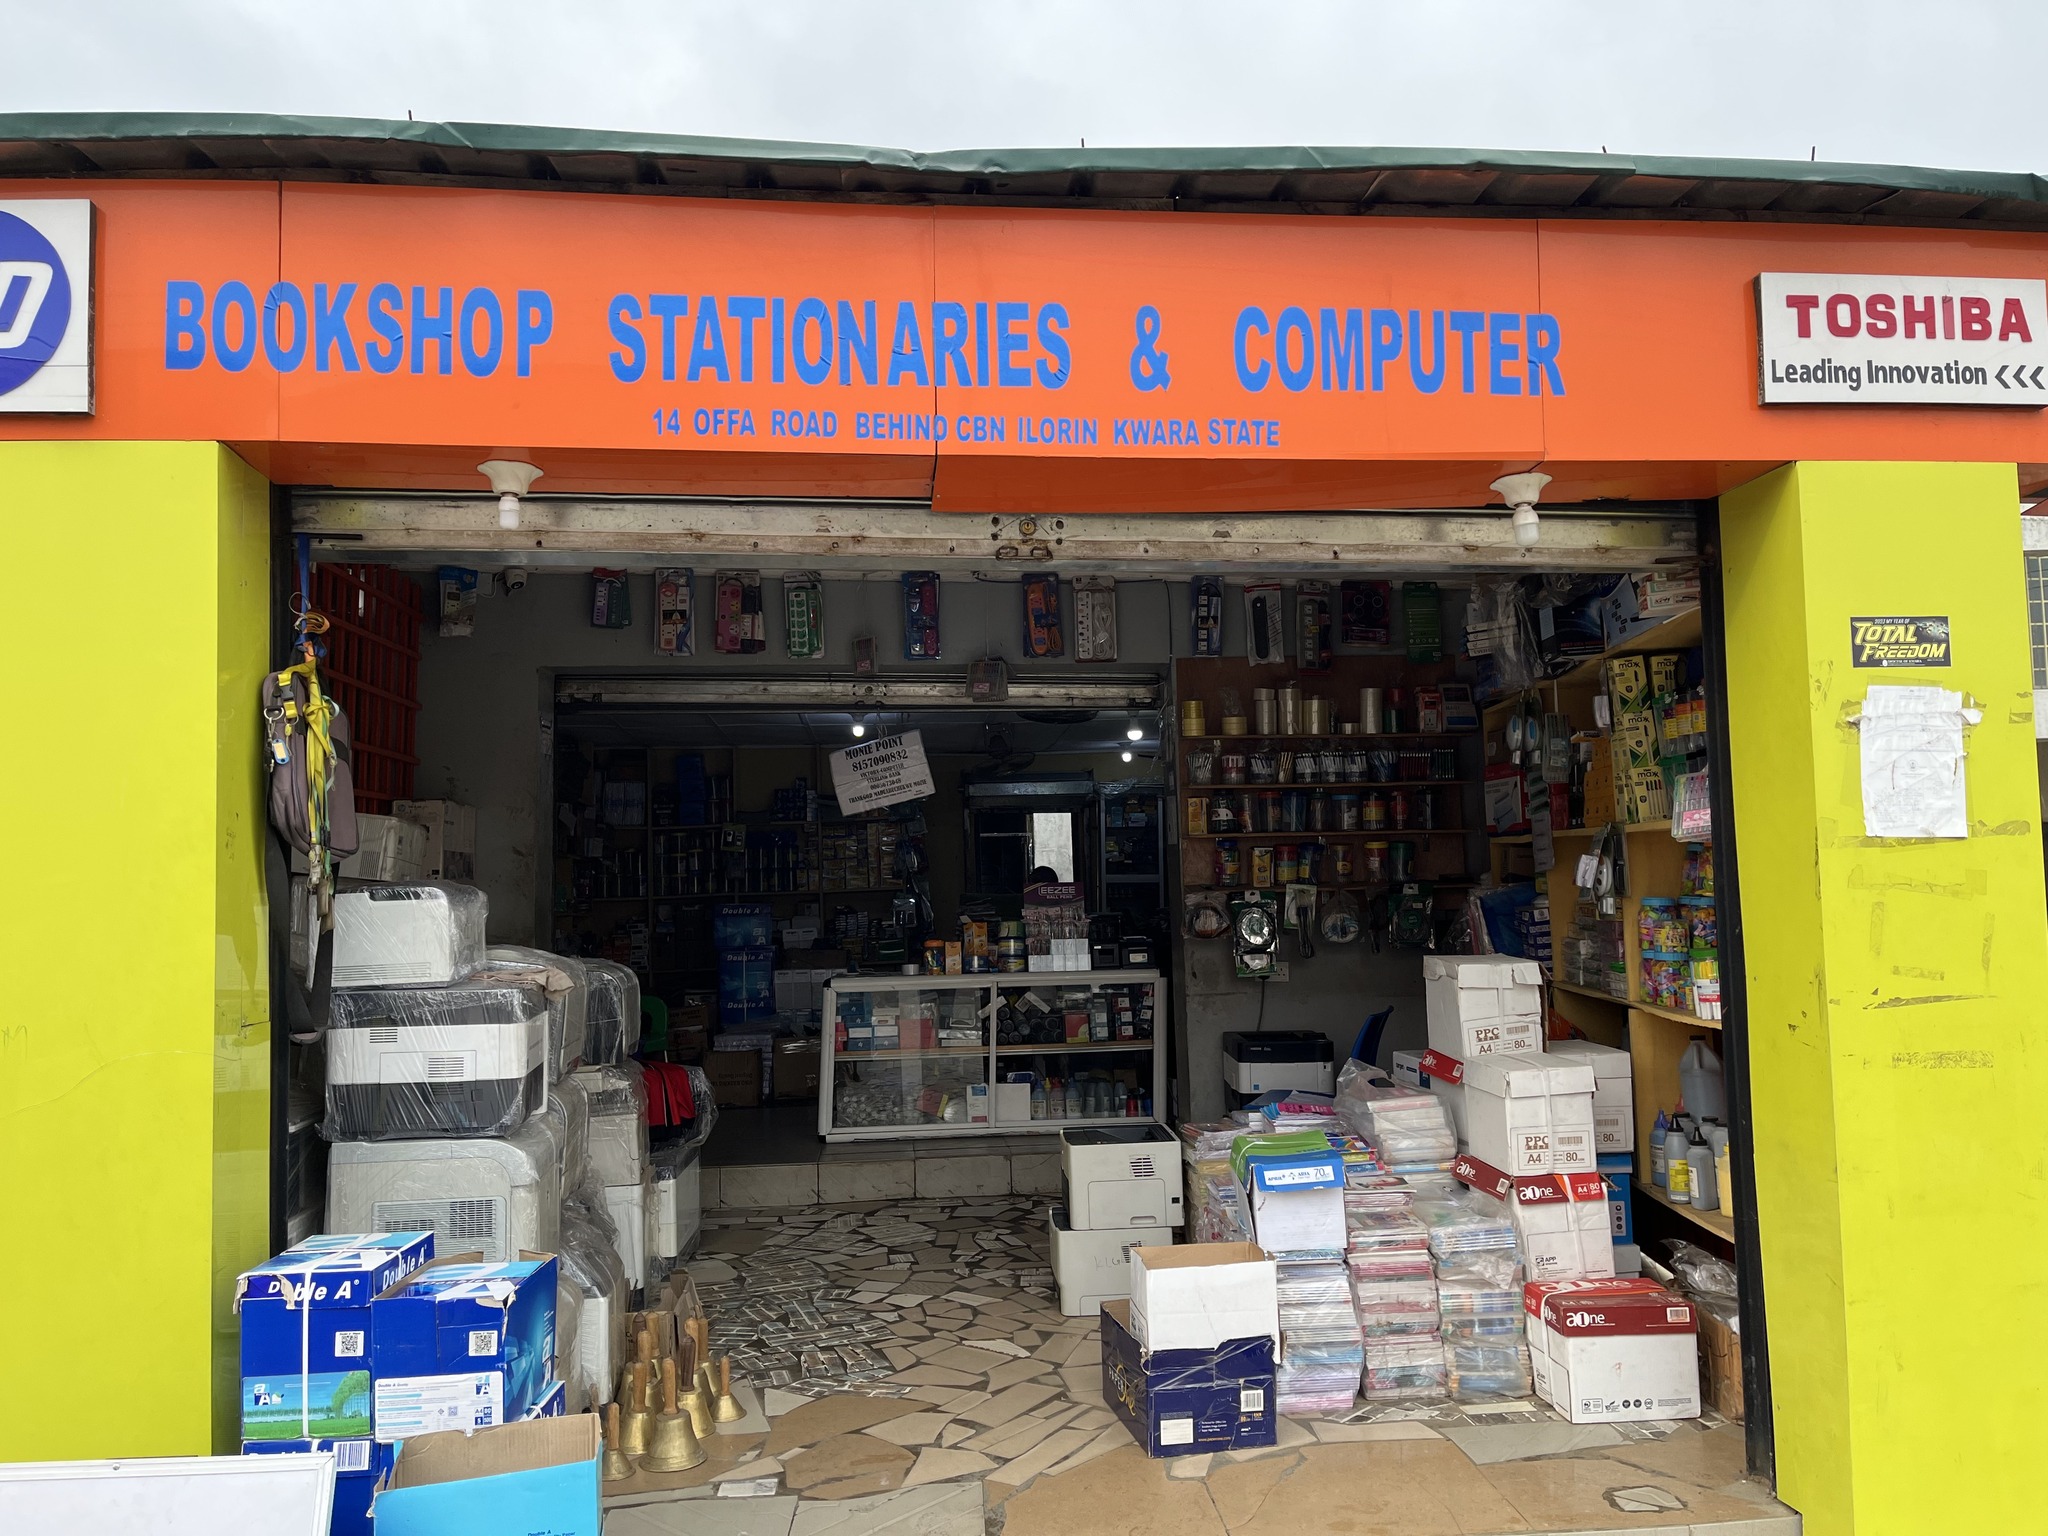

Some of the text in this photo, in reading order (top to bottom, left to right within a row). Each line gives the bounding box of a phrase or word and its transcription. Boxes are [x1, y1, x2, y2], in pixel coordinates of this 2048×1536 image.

[1786, 294, 2034, 342] TOSHIBA
[165, 280, 1567, 398] BOOKSHOP STATIONARIES & COMPUTER
[1770, 358, 1988, 391] Leading Innovation
[652, 408, 1281, 448] 14 OFFA ROAD BEHIND CBN ILORIN KWARA STATE
[1852, 620, 1918, 646] TOTAL
[1859, 642, 1947, 663] FREEDOM
[844, 735, 904, 761] MONIE POINT
[851, 748, 908, 773] 8157090832
[1475, 1027, 1500, 1038] PPC
[1479, 1044, 1493, 1054] A4
[1514, 1040, 1526, 1049] 80
[1602, 1133, 1614, 1142] 80
[1527, 1153, 1542, 1164] A4
[1565, 1152, 1578, 1162] 80
[1577, 1182, 1601, 1194] A4 80
[267, 1282, 328, 1301] Dble
